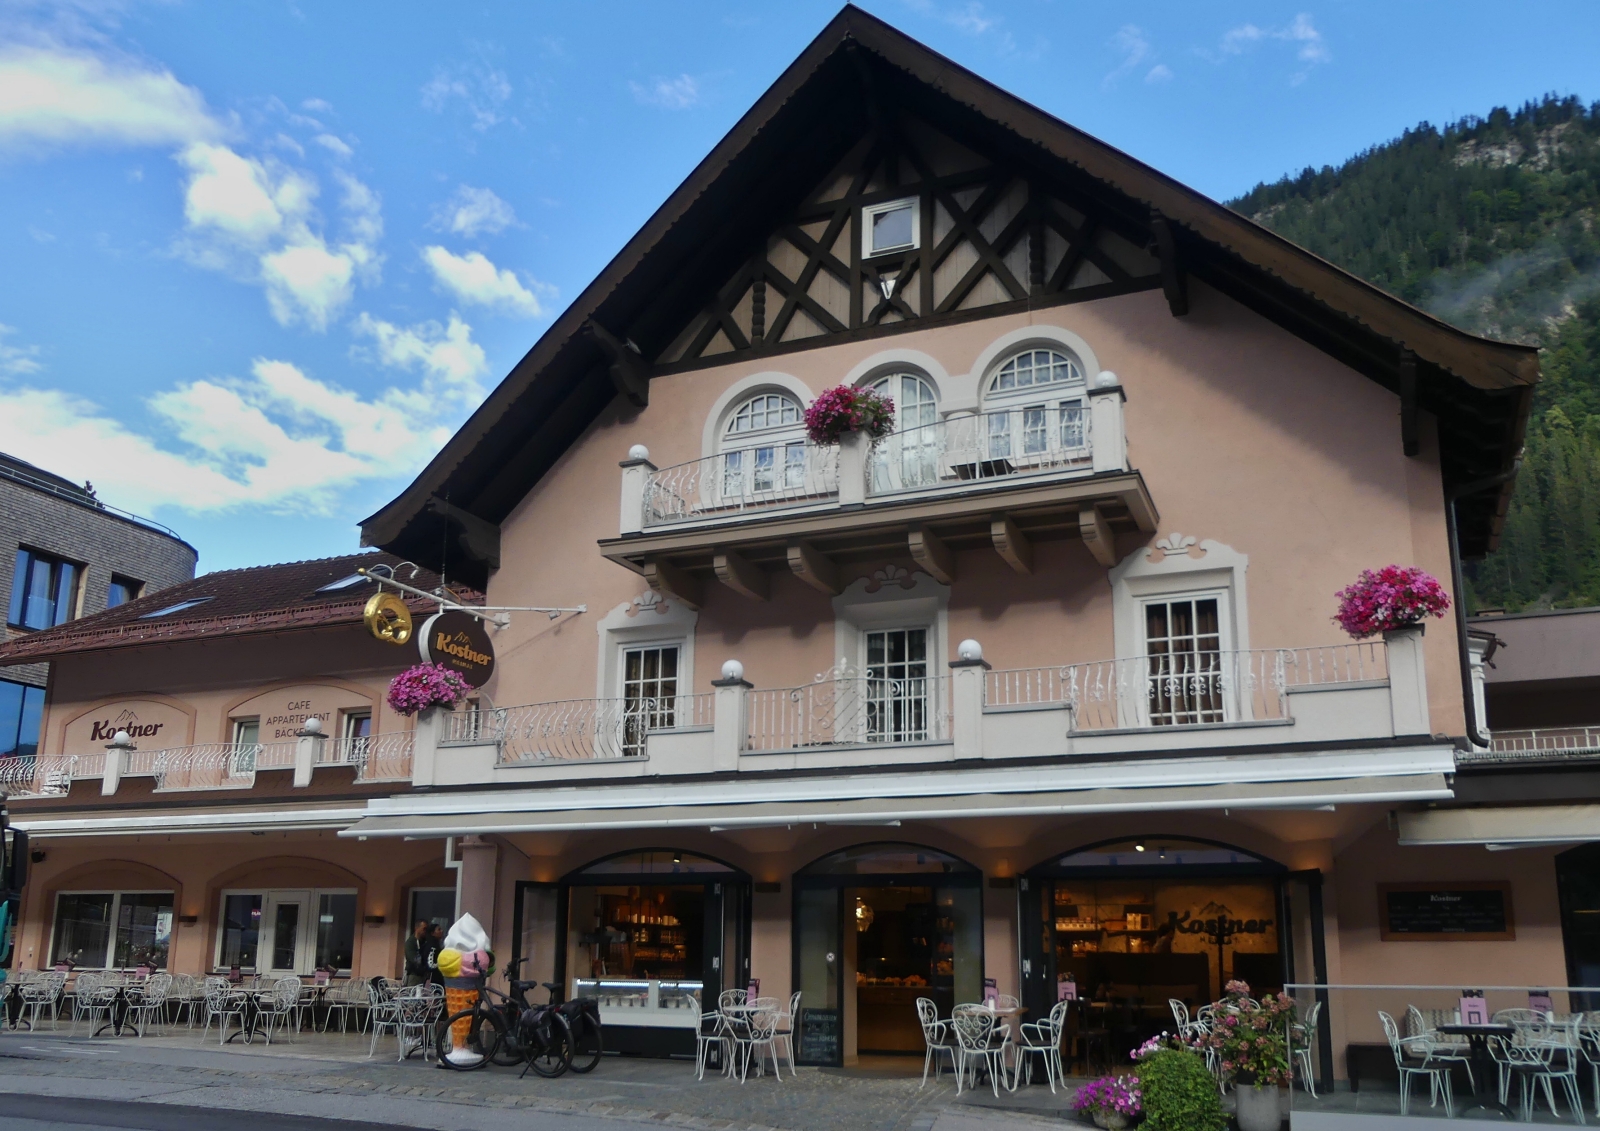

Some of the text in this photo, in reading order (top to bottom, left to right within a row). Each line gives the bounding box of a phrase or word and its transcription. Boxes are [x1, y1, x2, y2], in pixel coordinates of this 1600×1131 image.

[436, 632, 491, 665] Kostner
[287, 700, 311, 711] CAFE
[1430, 894, 1462, 902] Kostner
[1167, 910, 1273, 936] Kostner
